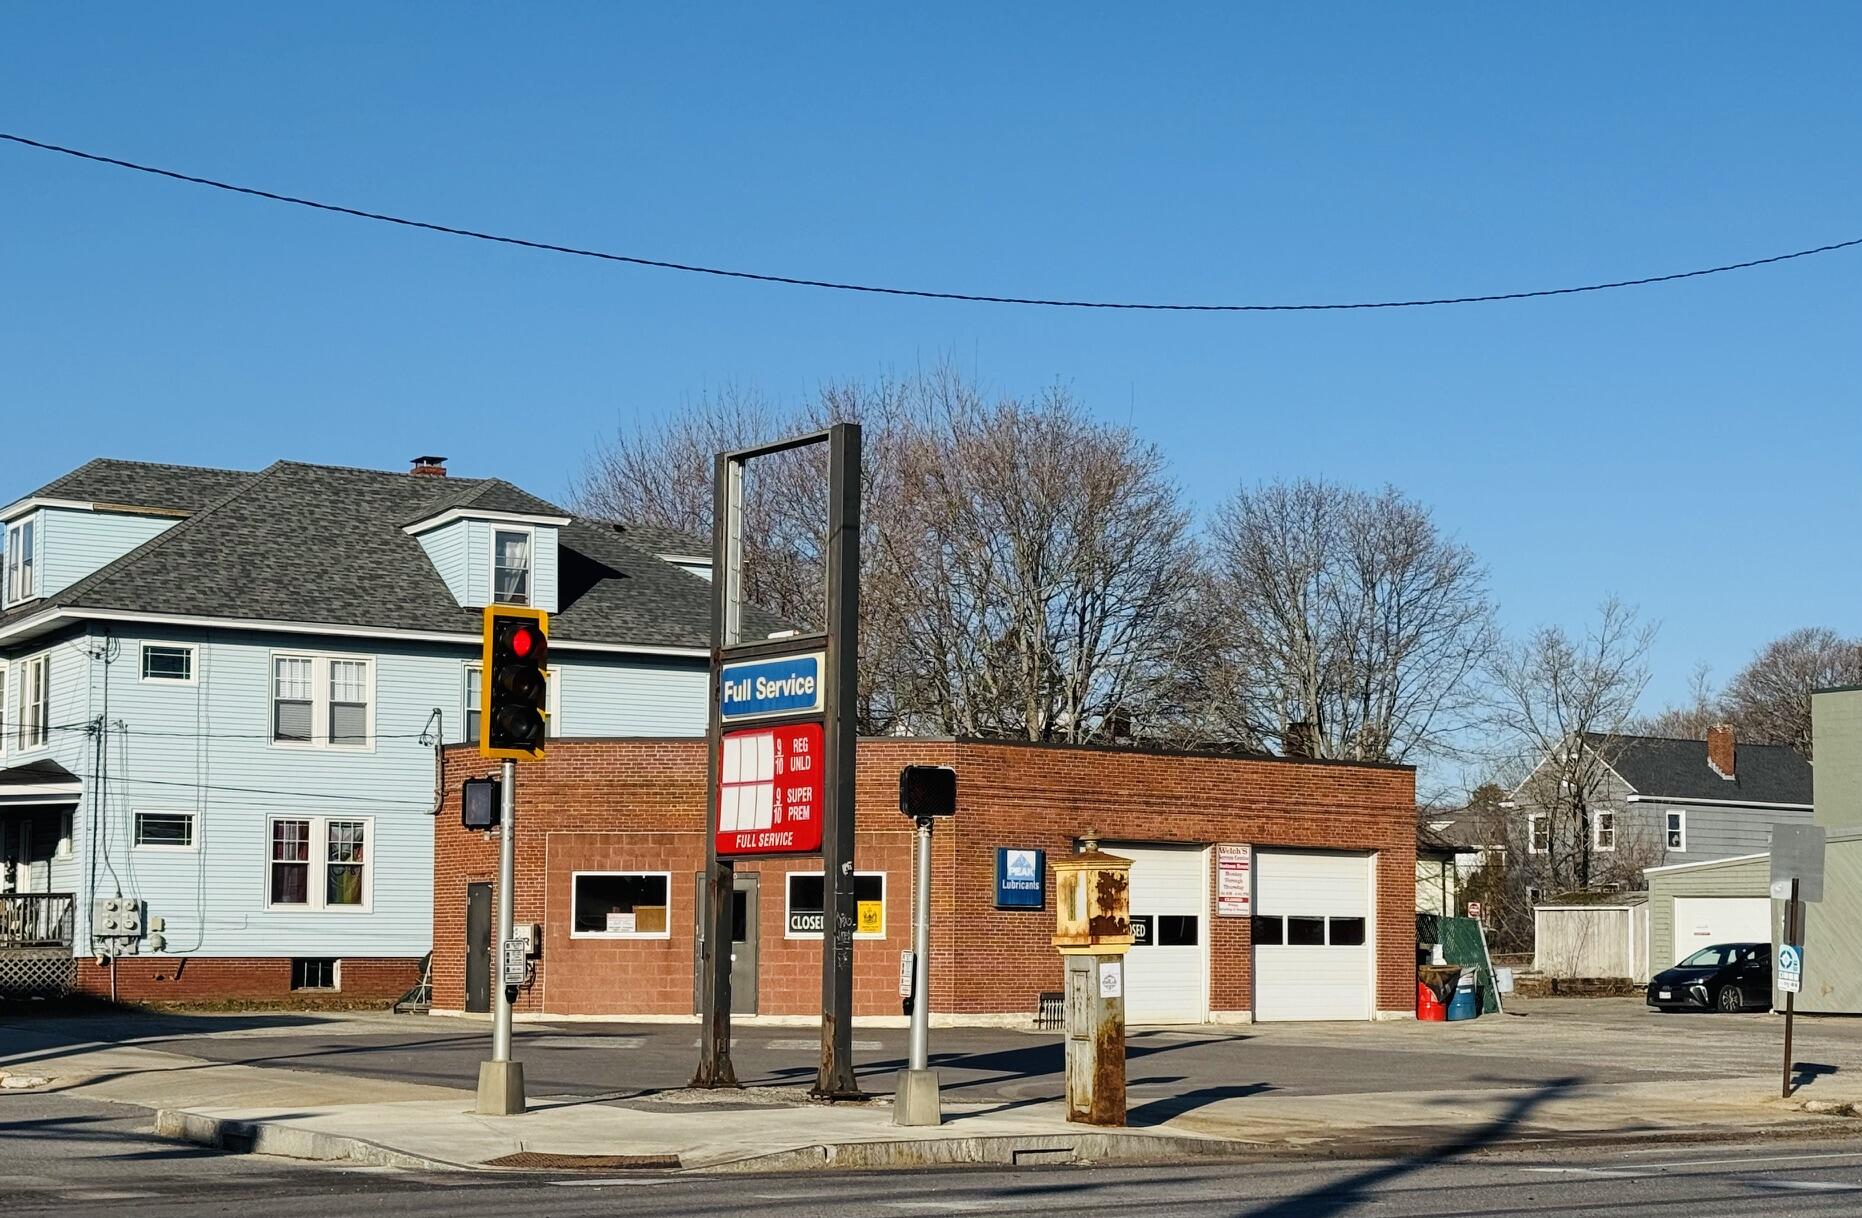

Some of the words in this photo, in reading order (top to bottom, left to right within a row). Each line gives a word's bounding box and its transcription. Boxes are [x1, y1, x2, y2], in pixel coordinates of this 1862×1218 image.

[724, 678, 752, 703] Full
[756, 673, 815, 700] Service
[793, 737, 809, 753] REG
[790, 755, 811, 772] UNLD
[786, 786, 813, 803] SUPER
[788, 804, 811, 821] PREM
[736, 834, 757, 848] FULL
[758, 832, 794, 846] SERVICE
[1008, 867, 1034, 876] PEAK
[1002, 880, 1040, 890] Lubricants
